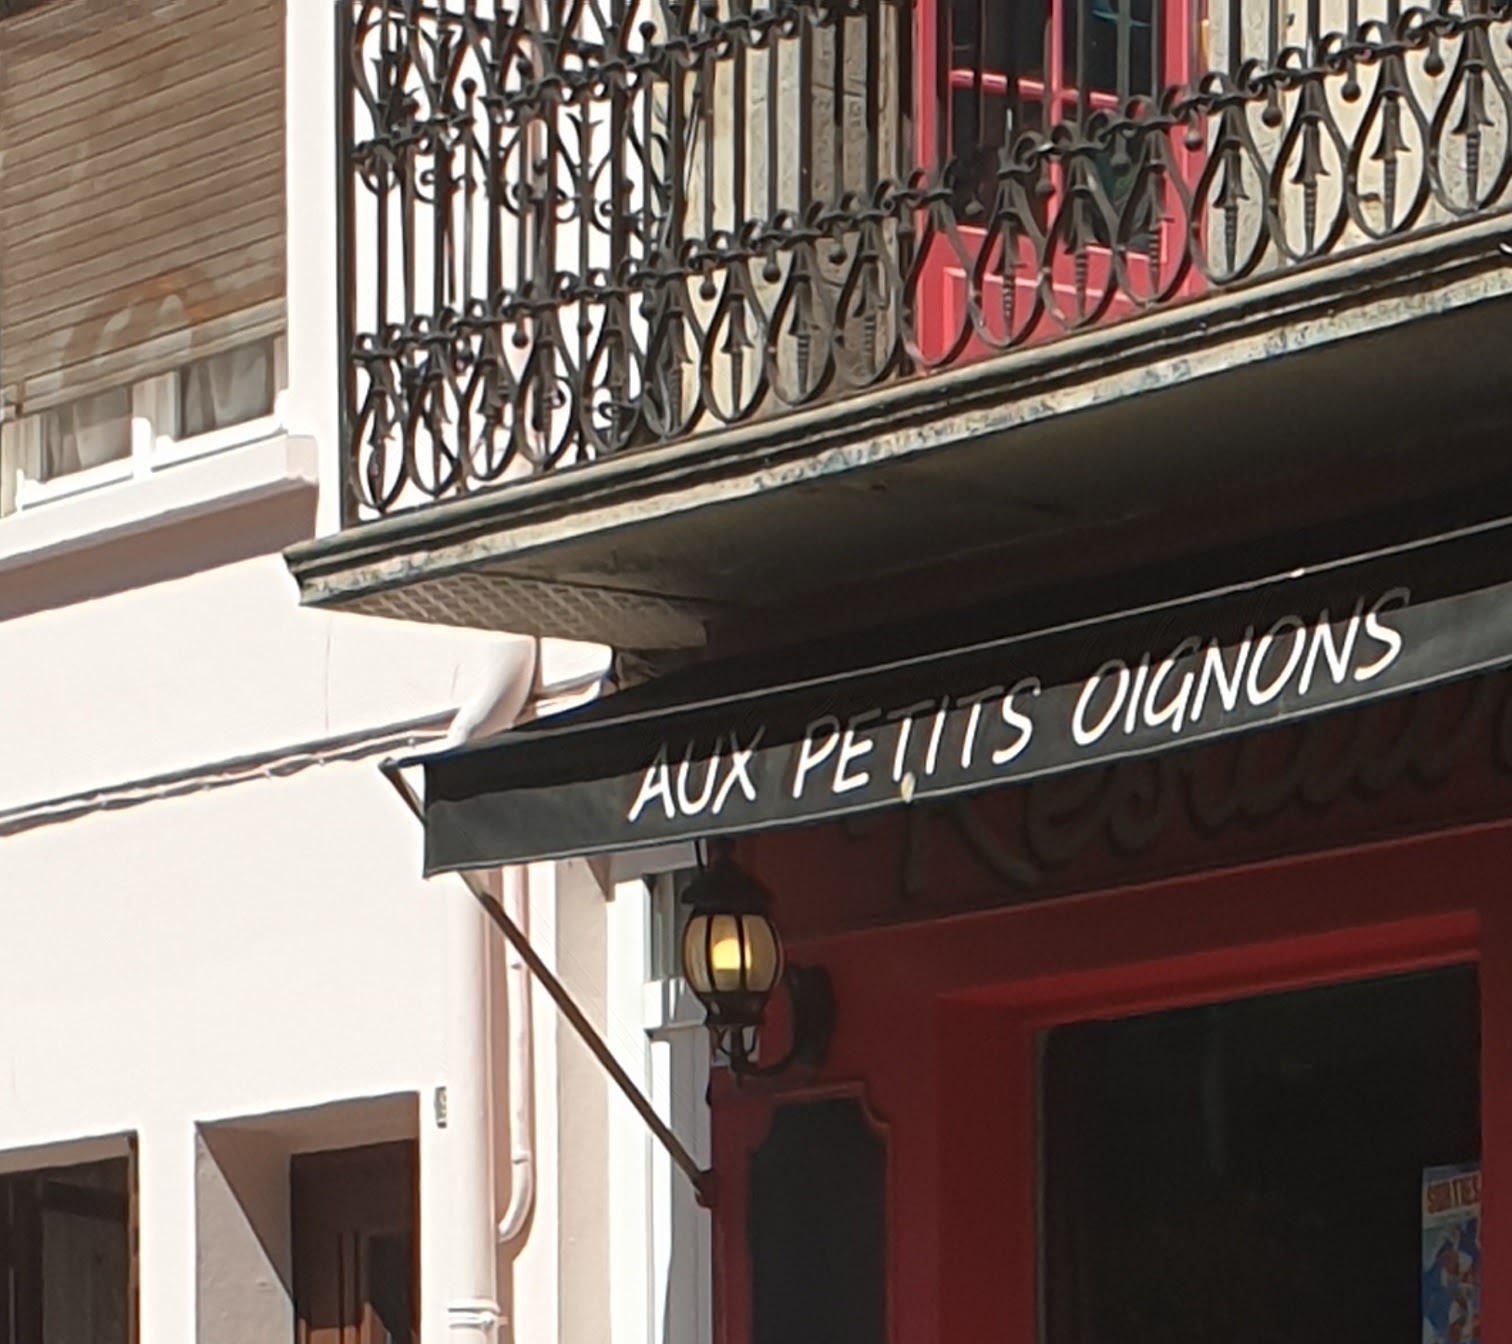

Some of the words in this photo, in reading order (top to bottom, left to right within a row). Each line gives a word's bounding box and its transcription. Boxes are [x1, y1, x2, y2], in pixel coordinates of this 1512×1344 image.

[628, 724, 766, 821] AUX
[791, 675, 1042, 799] PETITS
[1070, 588, 1411, 747] OIGNONS
